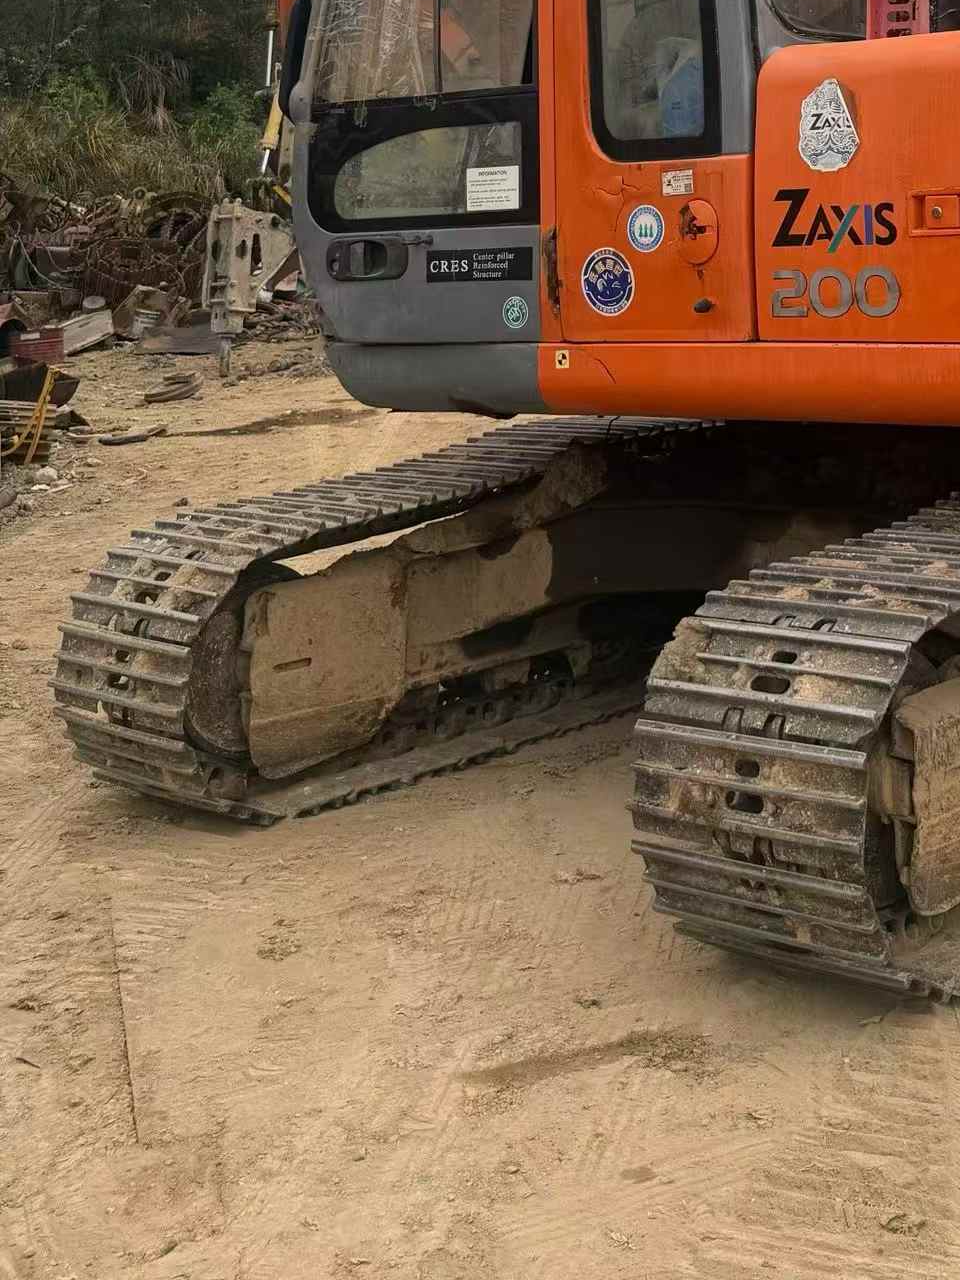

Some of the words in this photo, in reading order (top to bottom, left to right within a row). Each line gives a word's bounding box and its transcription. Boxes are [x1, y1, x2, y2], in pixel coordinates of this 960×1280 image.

[771, 188, 898, 253] ZAXIS
[497, 251, 515, 261] pillar
[430, 259, 469, 273] CRES
[473, 270, 502, 279] Structure
[771, 266, 901, 318] 200
